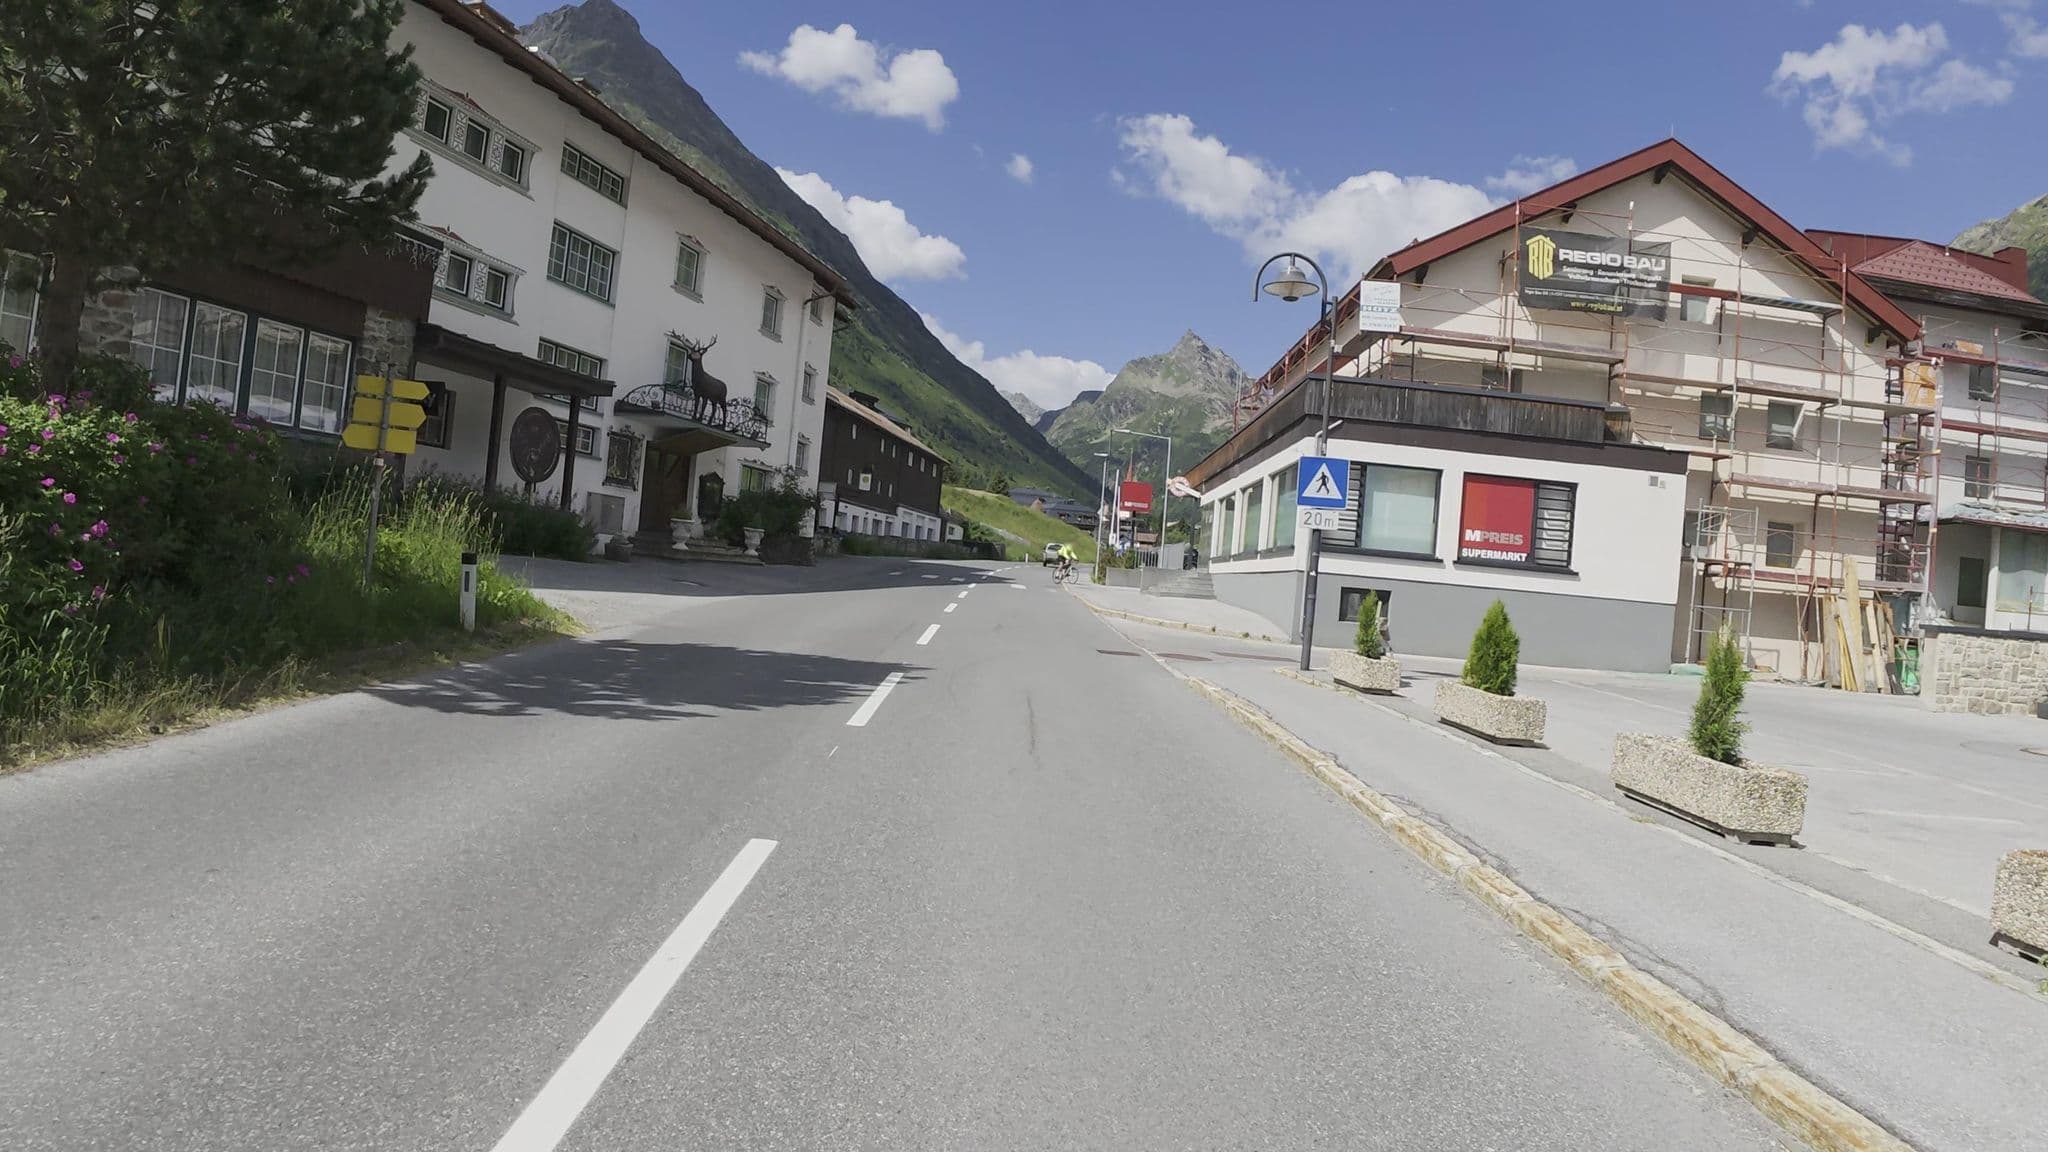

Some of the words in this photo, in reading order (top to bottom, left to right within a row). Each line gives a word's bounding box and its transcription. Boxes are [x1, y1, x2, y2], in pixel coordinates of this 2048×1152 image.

[1559, 248, 1622, 267] REGIO
[1623, 255, 1666, 271] BAU
[1464, 529, 1524, 545] MPREIS
[1461, 547, 1528, 562] SUPERMARKT
